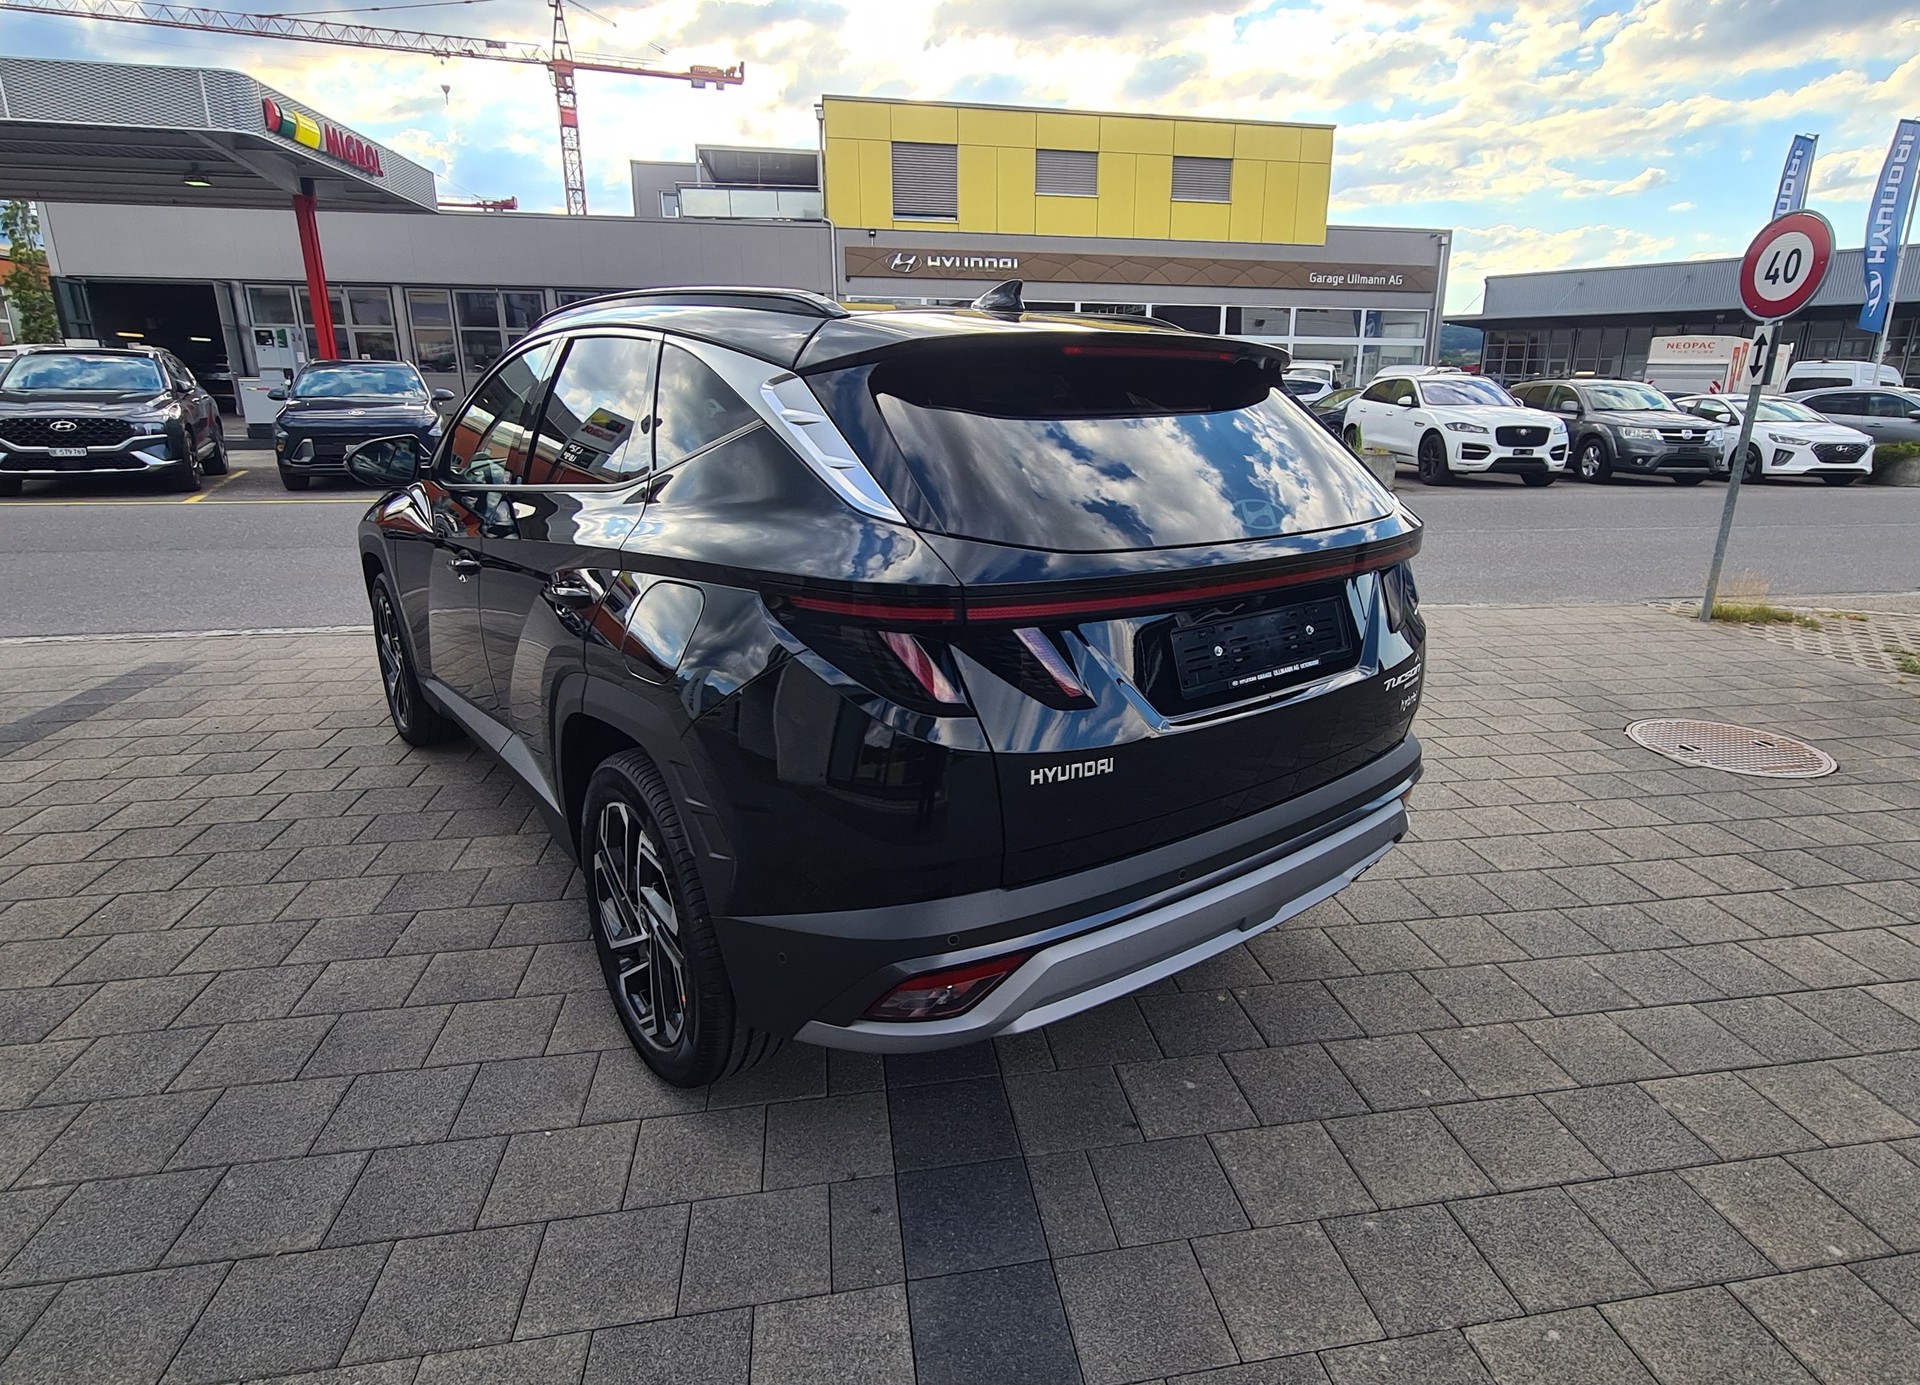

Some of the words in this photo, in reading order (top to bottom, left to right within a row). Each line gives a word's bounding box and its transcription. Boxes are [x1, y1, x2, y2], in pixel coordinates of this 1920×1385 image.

[324, 123, 384, 177] MIGROL
[1309, 272, 1345, 286] Garage
[1347, 273, 1386, 284] Ullmann
[1388, 275, 1403, 285] AG
[1764, 248, 1802, 285] 40
[1666, 341, 1716, 349] NEOPAC
[1383, 662, 1421, 692] TUCSON
[1030, 757, 1114, 786] HYUNDAI
